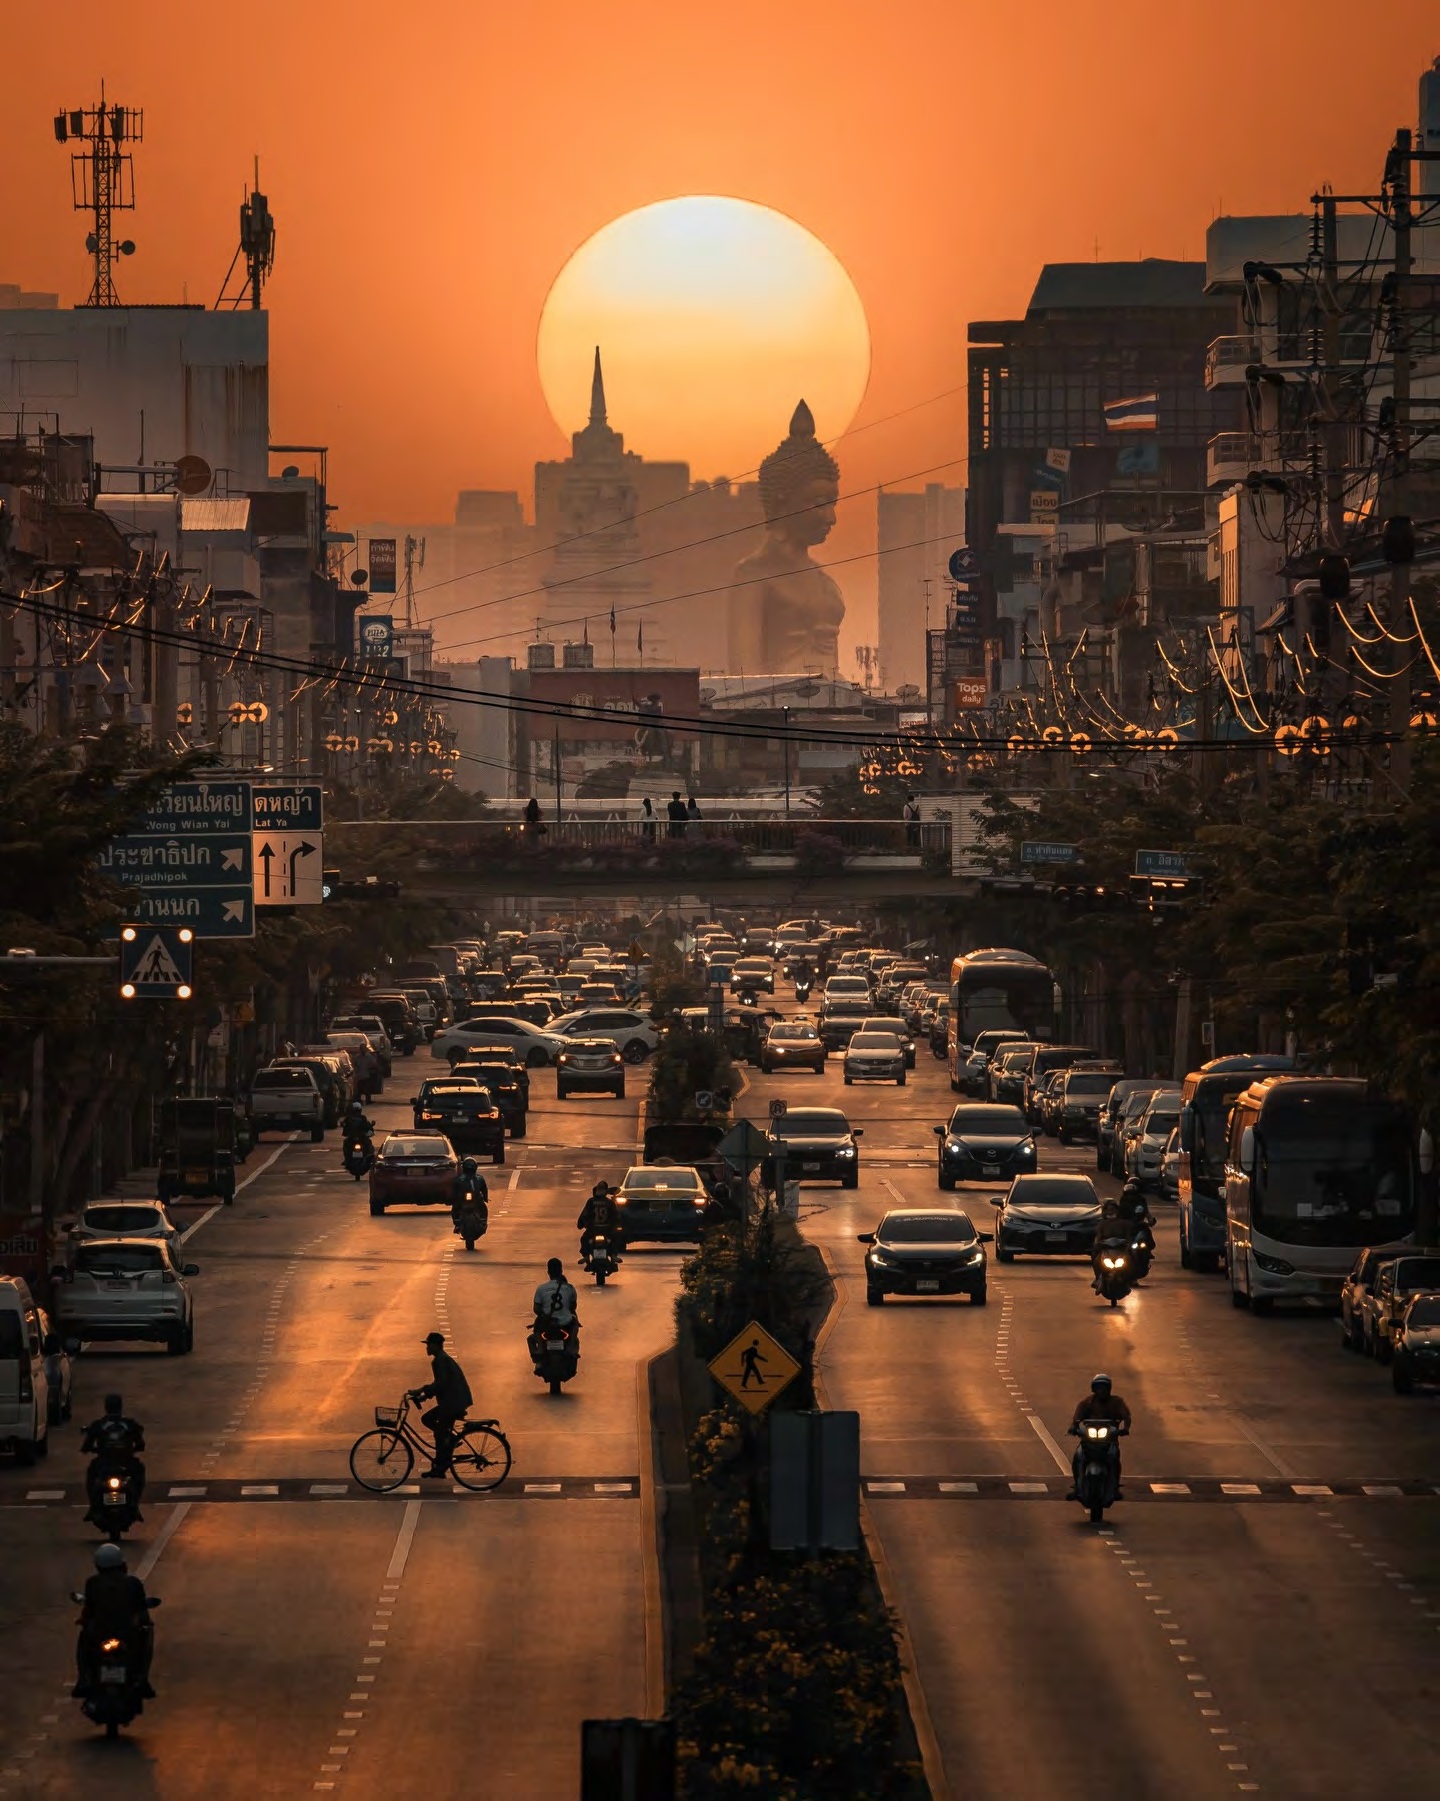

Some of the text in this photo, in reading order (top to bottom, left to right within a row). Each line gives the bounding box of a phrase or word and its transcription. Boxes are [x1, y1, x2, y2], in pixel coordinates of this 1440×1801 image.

[367, 628, 385, 638] PIZZA
[956, 682, 987, 694] Tops
[961, 695, 982, 704] daily
[181, 819, 209, 829] Wian
[214, 819, 230, 829] Yai
[255, 818, 288, 828] Lat Ya
[100, 839, 211, 867] ประชาธิปก
[121, 872, 188, 884] Prajadhipok
[550, 1292, 564, 1312] 8
